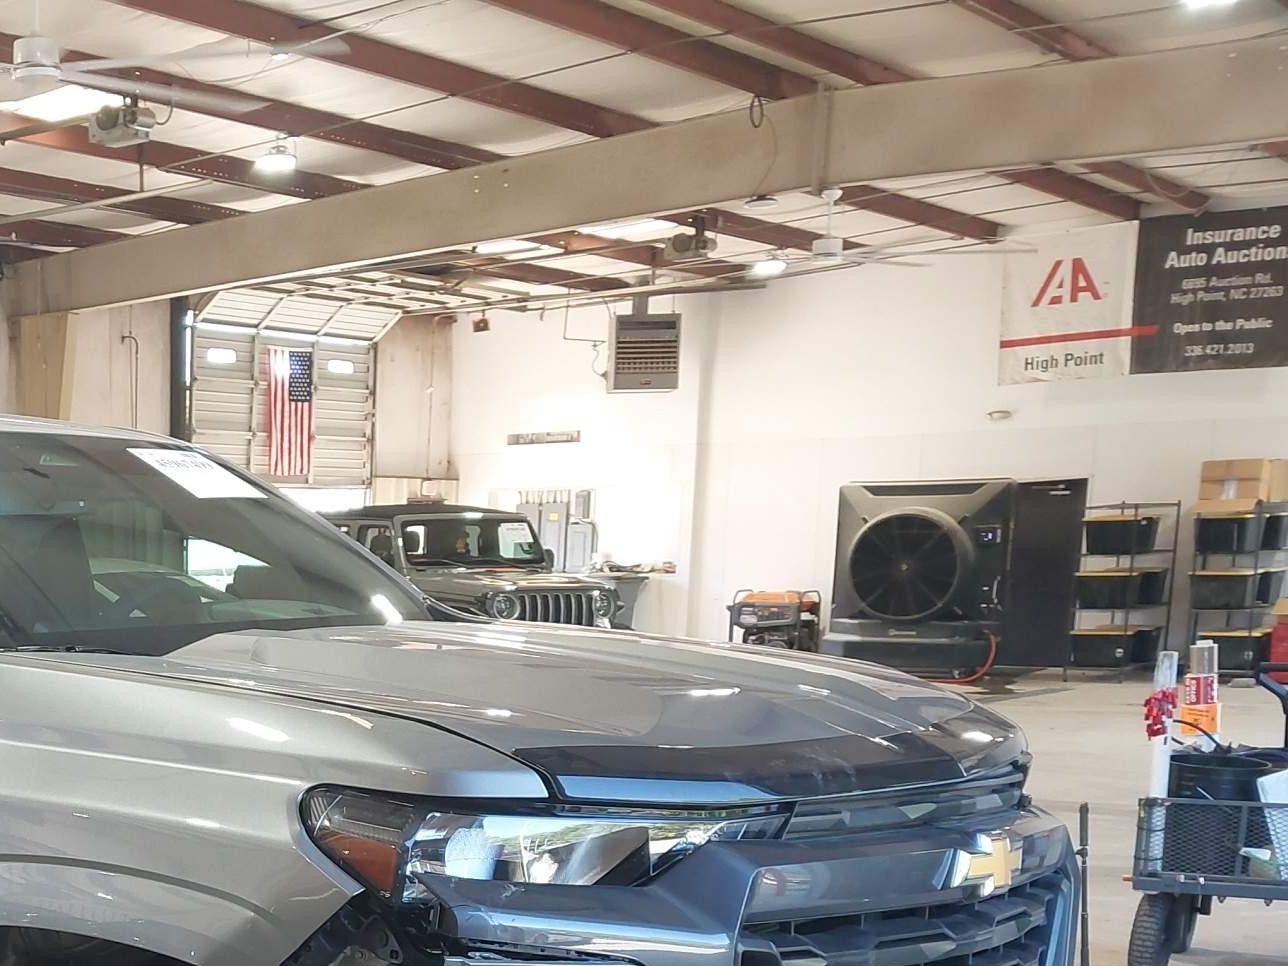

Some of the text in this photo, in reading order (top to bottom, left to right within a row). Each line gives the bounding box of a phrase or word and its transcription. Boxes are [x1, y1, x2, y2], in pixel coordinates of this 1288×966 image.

[1186, 225, 1282, 246] Insurance
[1164, 244, 1288, 268] Auto Auction
[1209, 275, 1253, 287] Auction
[1170, 292, 1195, 305] High
[1229, 288, 1248, 300] NC
[1173, 317, 1273, 336] Open to the Public
[1024, 352, 1104, 372] High Point
